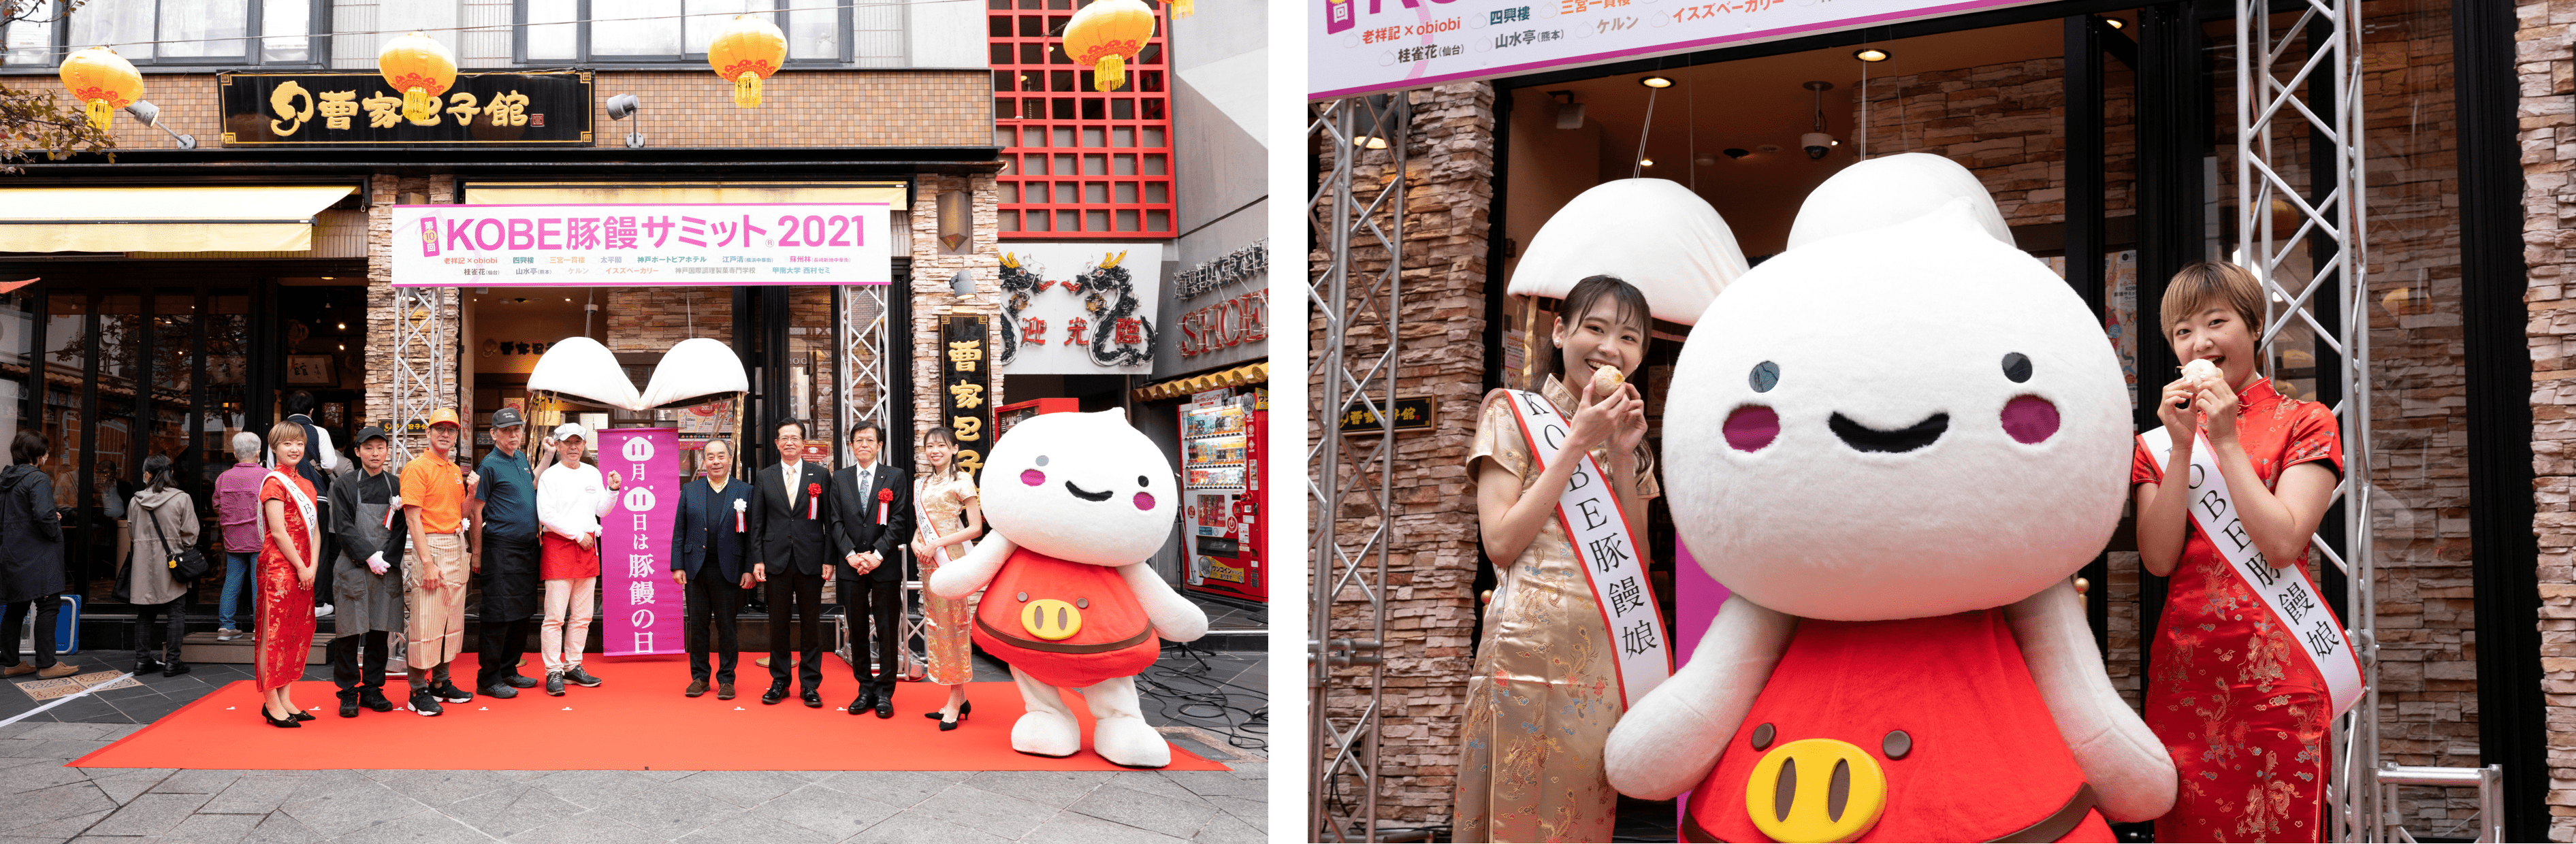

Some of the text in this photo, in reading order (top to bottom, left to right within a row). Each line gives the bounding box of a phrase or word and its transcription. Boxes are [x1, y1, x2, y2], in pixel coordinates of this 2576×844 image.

[1596, 16, 1639, 34] ケルン
[1672, 0, 1785, 23] イスズベーカリー
[948, 340, 984, 510] 曹家包子
[2164, 447, 2340, 664] OBE豚饅娘
